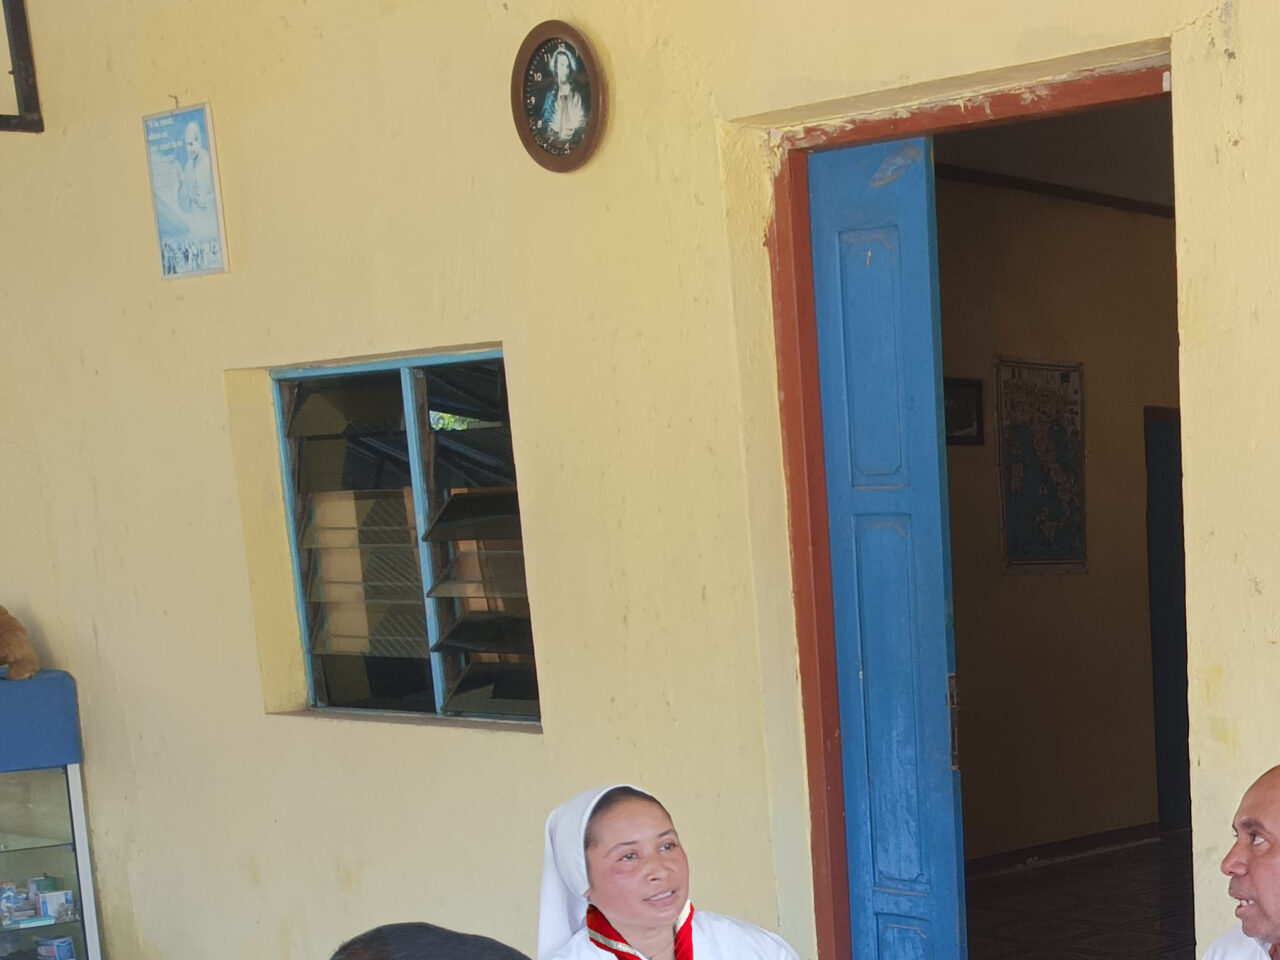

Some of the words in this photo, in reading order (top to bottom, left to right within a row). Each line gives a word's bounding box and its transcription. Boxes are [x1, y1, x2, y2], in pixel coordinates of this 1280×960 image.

[544, 53, 551, 62] 11
[533, 72, 543, 82] 10
[530, 96, 536, 105] 9
[537, 120, 543, 129] 8
